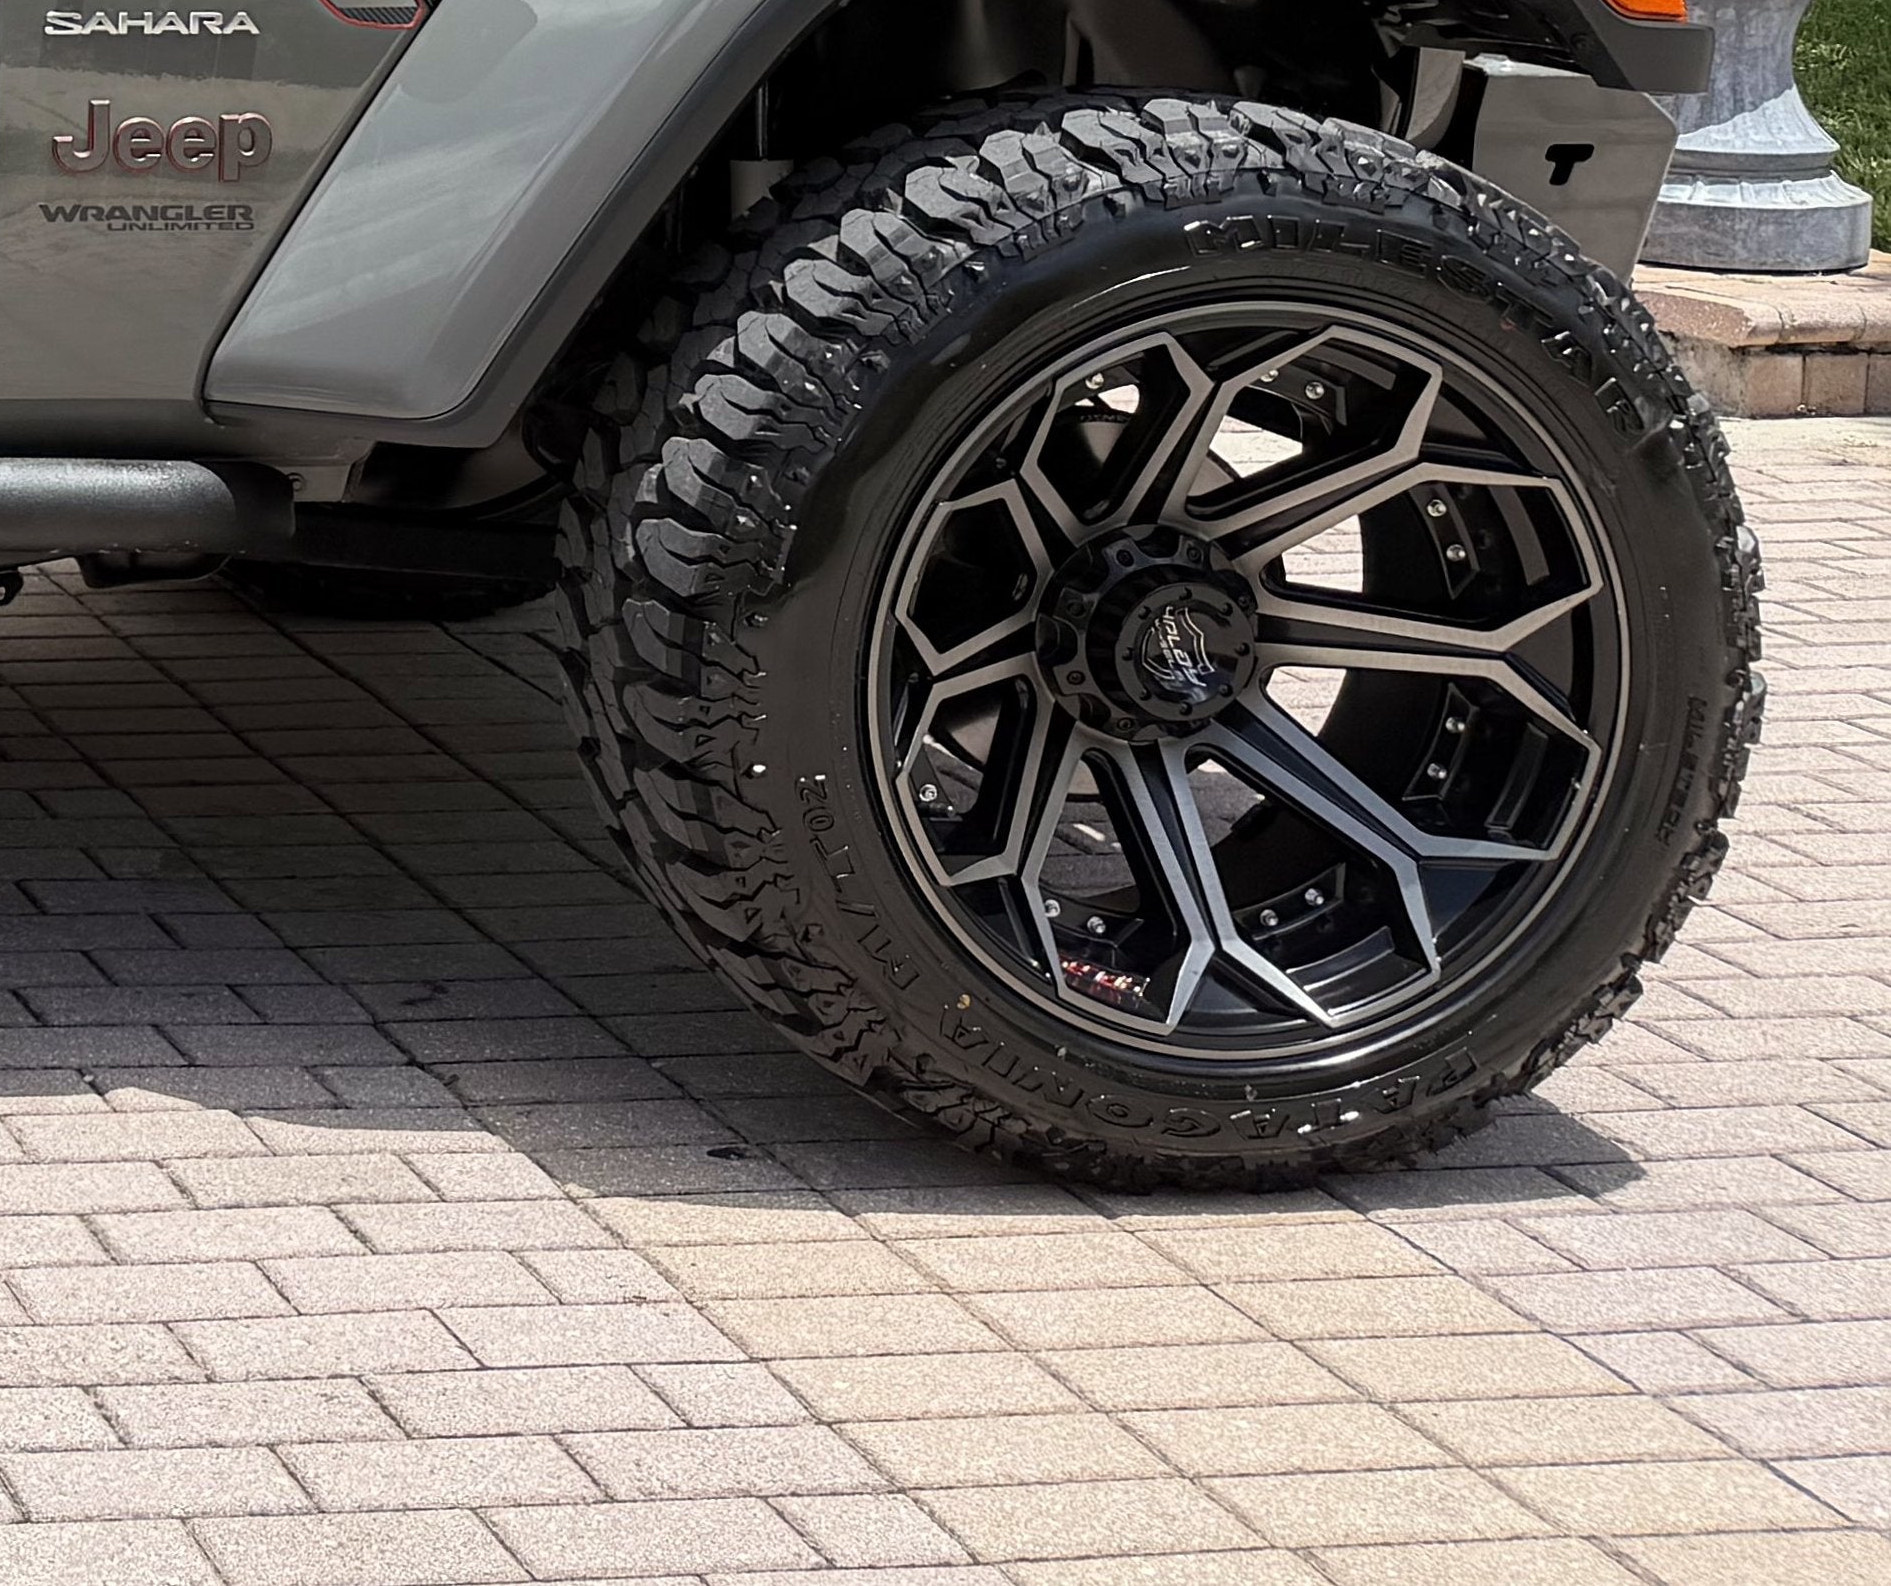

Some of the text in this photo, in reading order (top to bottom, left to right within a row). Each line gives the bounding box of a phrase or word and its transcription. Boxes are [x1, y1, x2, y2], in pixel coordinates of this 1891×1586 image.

[43, 10, 261, 36] SAHARA
[51, 98, 274, 183] Jeep
[38, 203, 254, 223] WRANGLER
[106, 222, 255, 232] UNLIMITED
[1181, 213, 1648, 438] MILESTAR
[939, 1004, 1480, 1141] PATAGONIA
